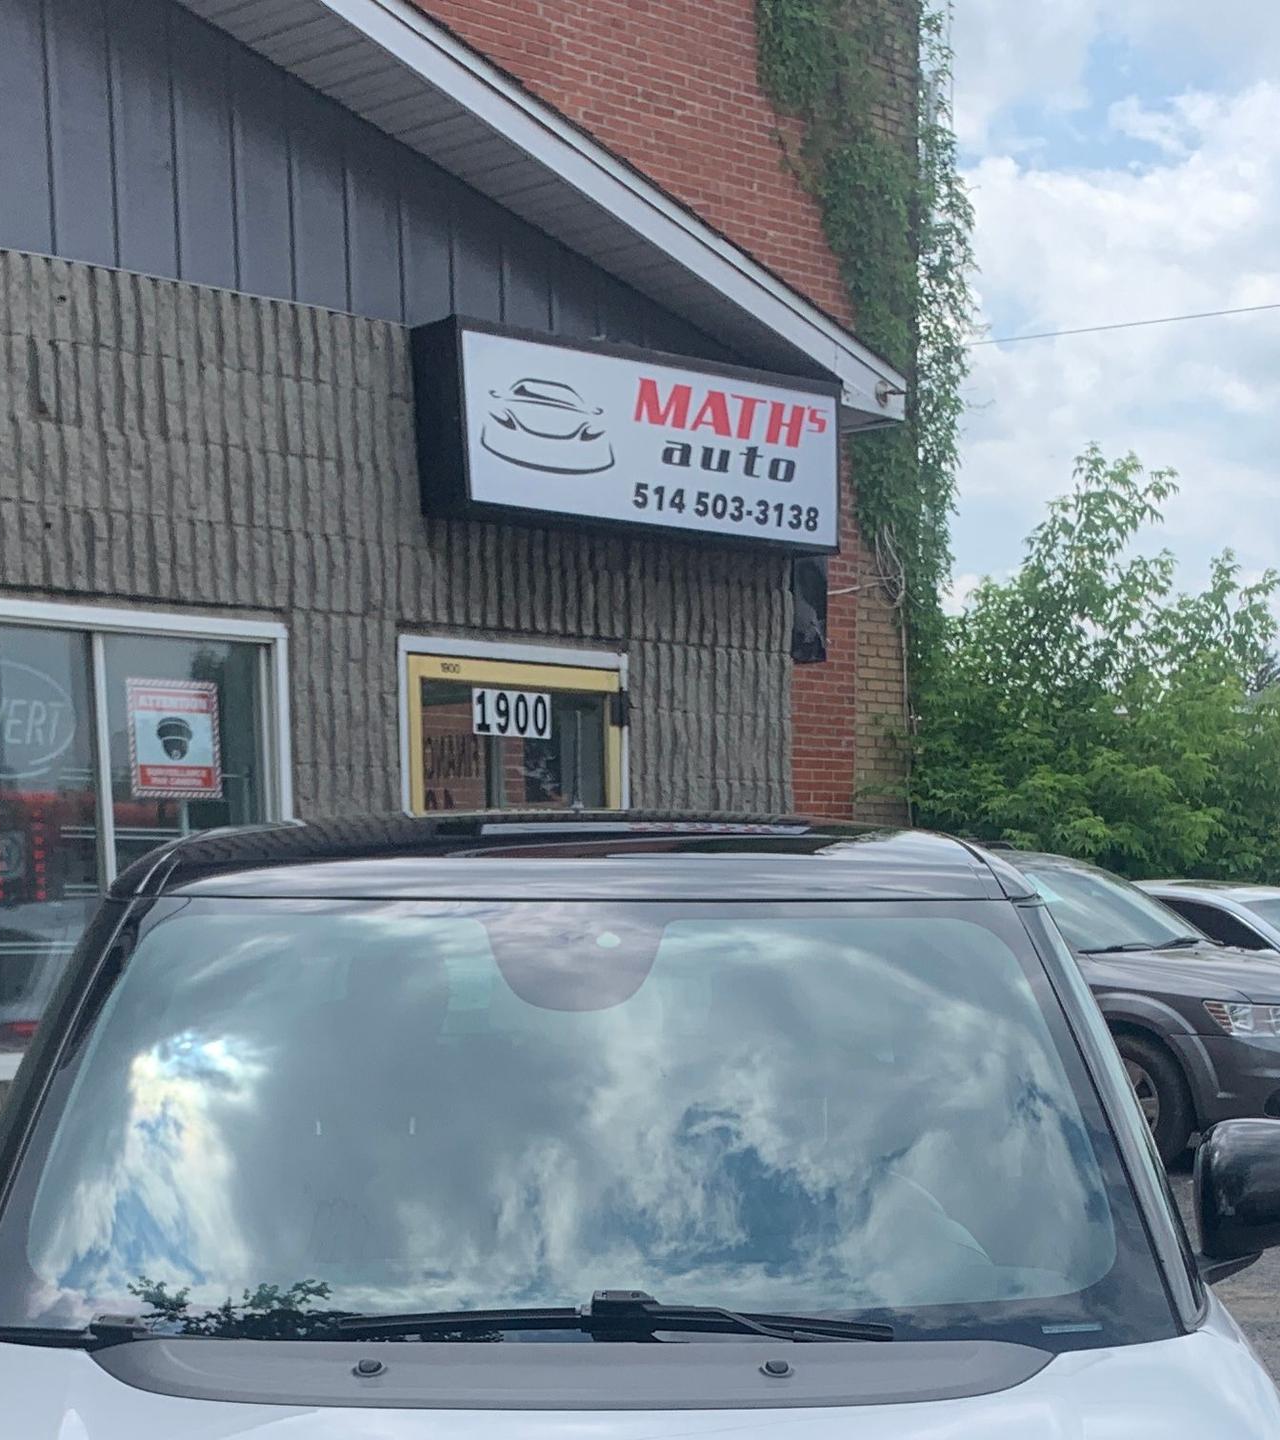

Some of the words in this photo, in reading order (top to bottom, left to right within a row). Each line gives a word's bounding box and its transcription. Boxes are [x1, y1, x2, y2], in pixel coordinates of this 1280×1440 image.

[661, 440, 796, 483] auto
[632, 482, 686, 514] 514
[694, 490, 820, 532] 503-3138
[475, 690, 547, 737] 1900
